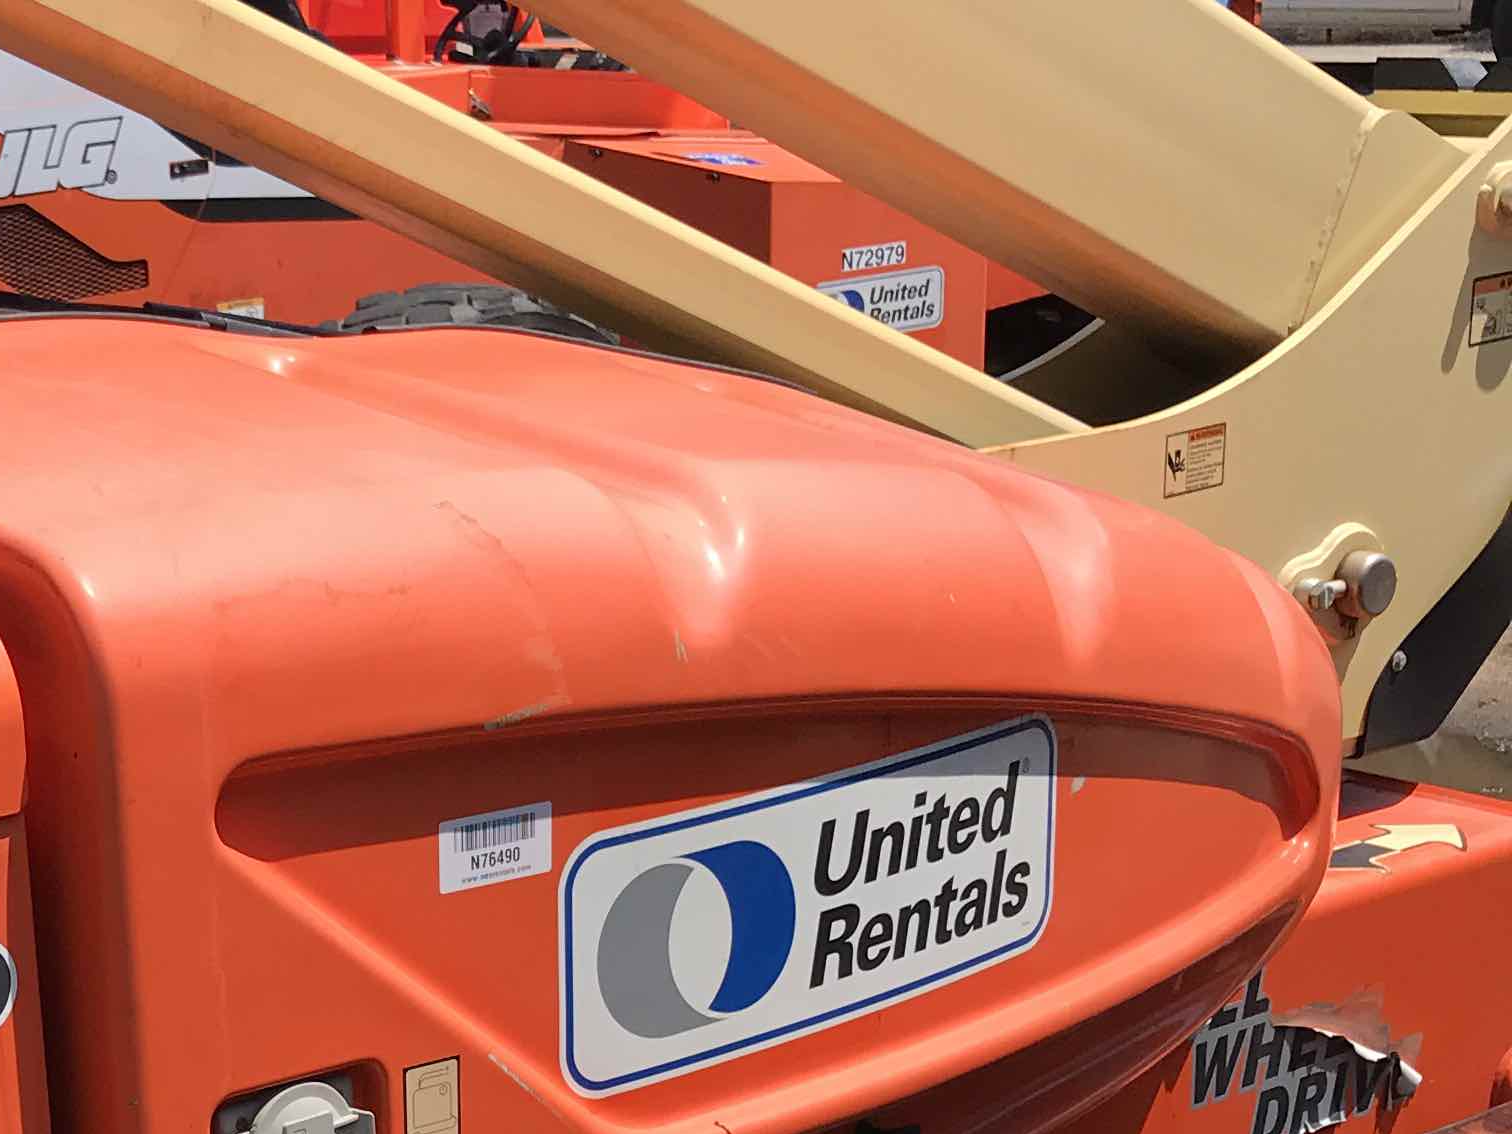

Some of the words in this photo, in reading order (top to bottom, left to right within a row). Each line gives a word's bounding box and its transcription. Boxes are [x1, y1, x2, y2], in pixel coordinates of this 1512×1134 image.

[841, 244, 905, 270] N72979
[870, 278, 930, 305] United
[870, 301, 935, 324] Rentals
[814, 760, 1021, 897] United
[471, 847, 521, 870] N76490
[809, 849, 1031, 989] Rentals
